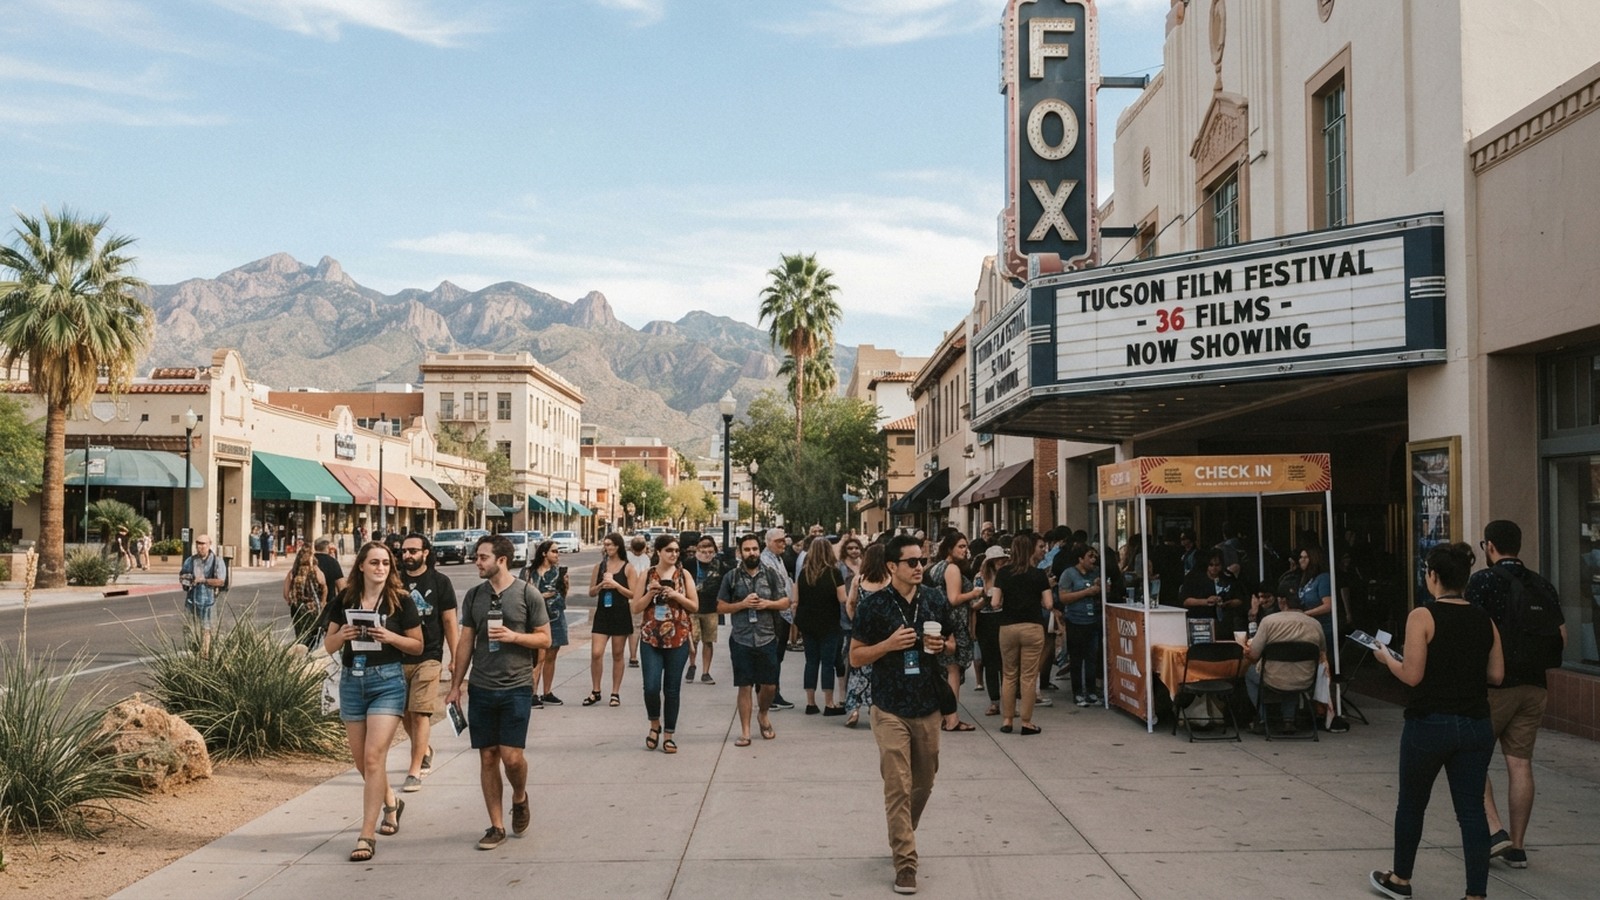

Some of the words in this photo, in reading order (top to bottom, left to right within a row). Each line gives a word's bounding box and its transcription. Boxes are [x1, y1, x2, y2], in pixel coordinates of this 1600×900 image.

[1027, 17, 1079, 241] FOX
[1077, 279, 1165, 313] TUCSON
[1177, 269, 1232, 300] FILM
[1245, 249, 1373, 291] FESTIVAL
[1156, 307, 1185, 333] 36
[1196, 296, 1270, 328] FILMS
[1127, 339, 1178, 367] NOW
[1190, 323, 1311, 360] SHOWING
[1194, 465, 1250, 479] CHECK
[1254, 464, 1272, 477] IN
